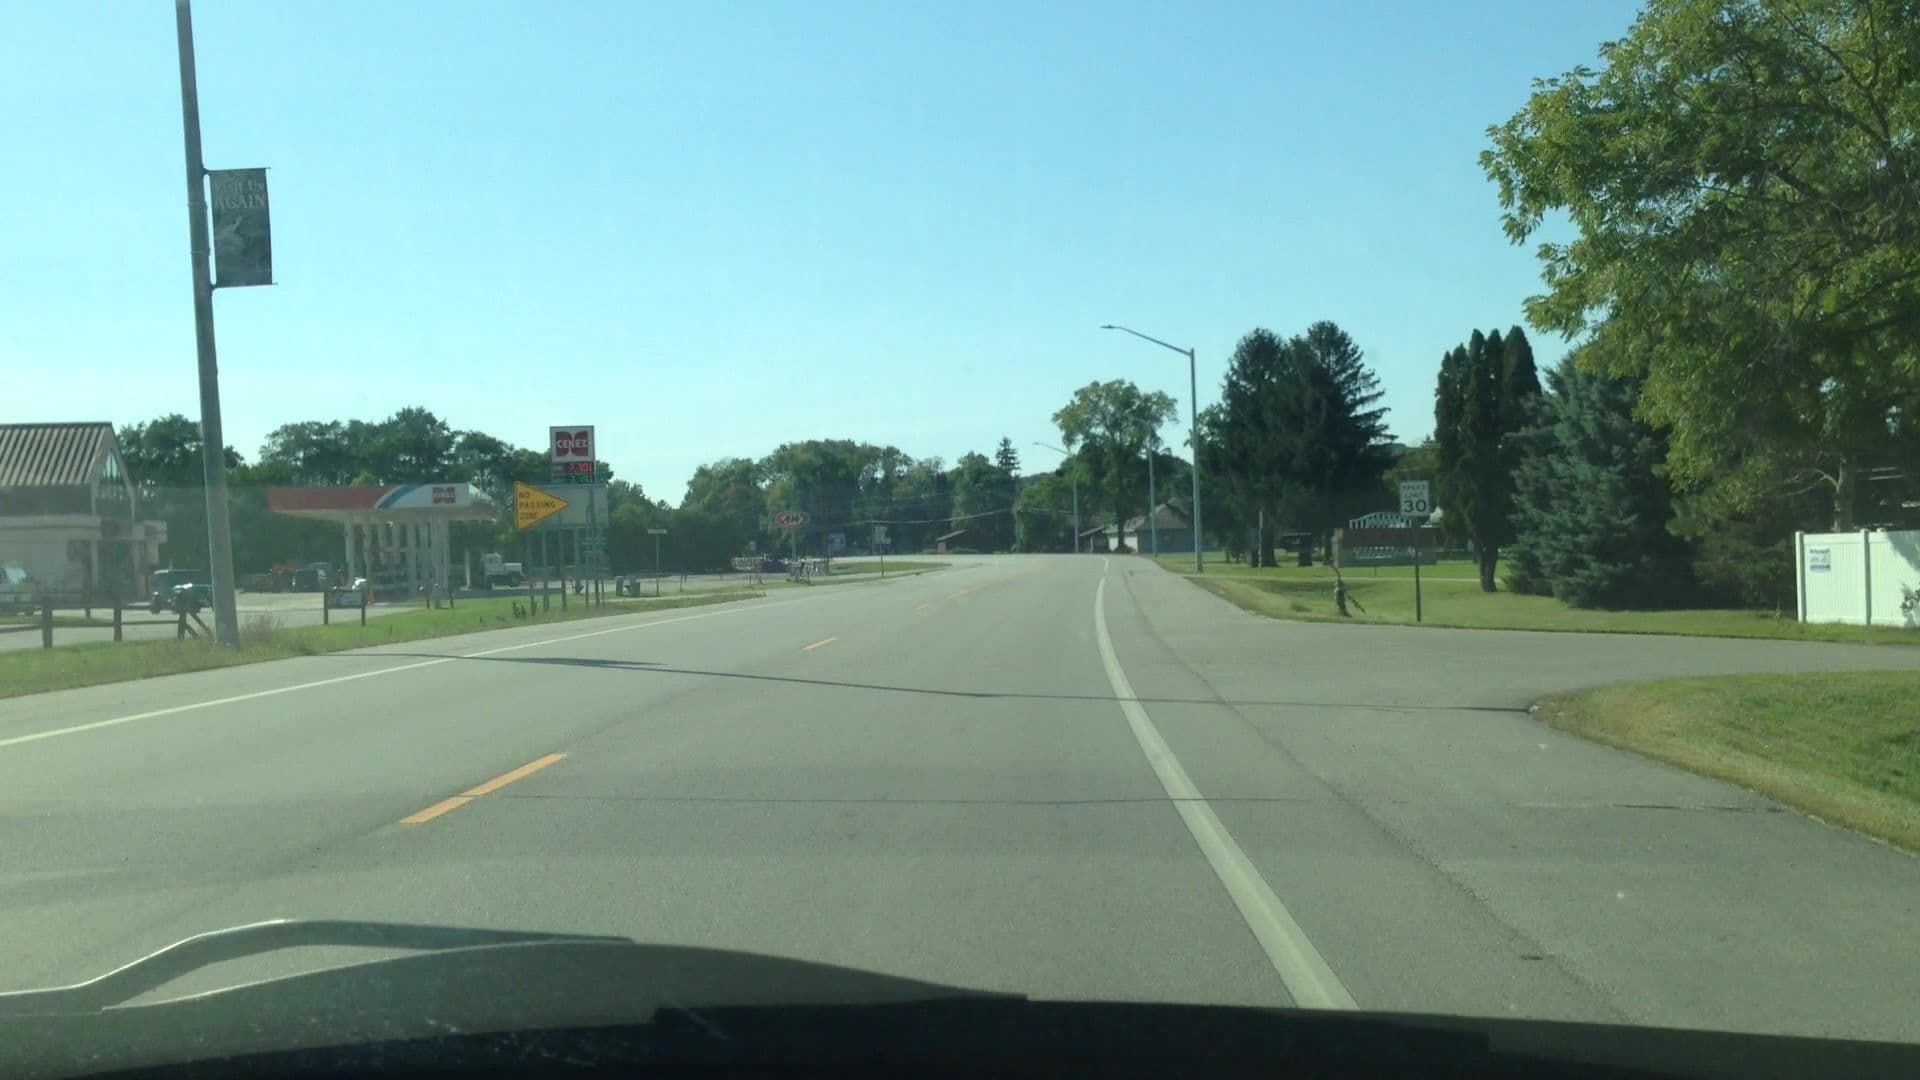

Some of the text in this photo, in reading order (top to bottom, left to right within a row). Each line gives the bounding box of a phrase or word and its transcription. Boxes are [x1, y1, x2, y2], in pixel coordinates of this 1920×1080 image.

[214, 194, 265, 209] AGAIN
[556, 439, 589, 449] CENEX
[519, 492, 530, 500] NO
[519, 501, 557, 510] PASSING
[1403, 499, 1427, 513] 30
